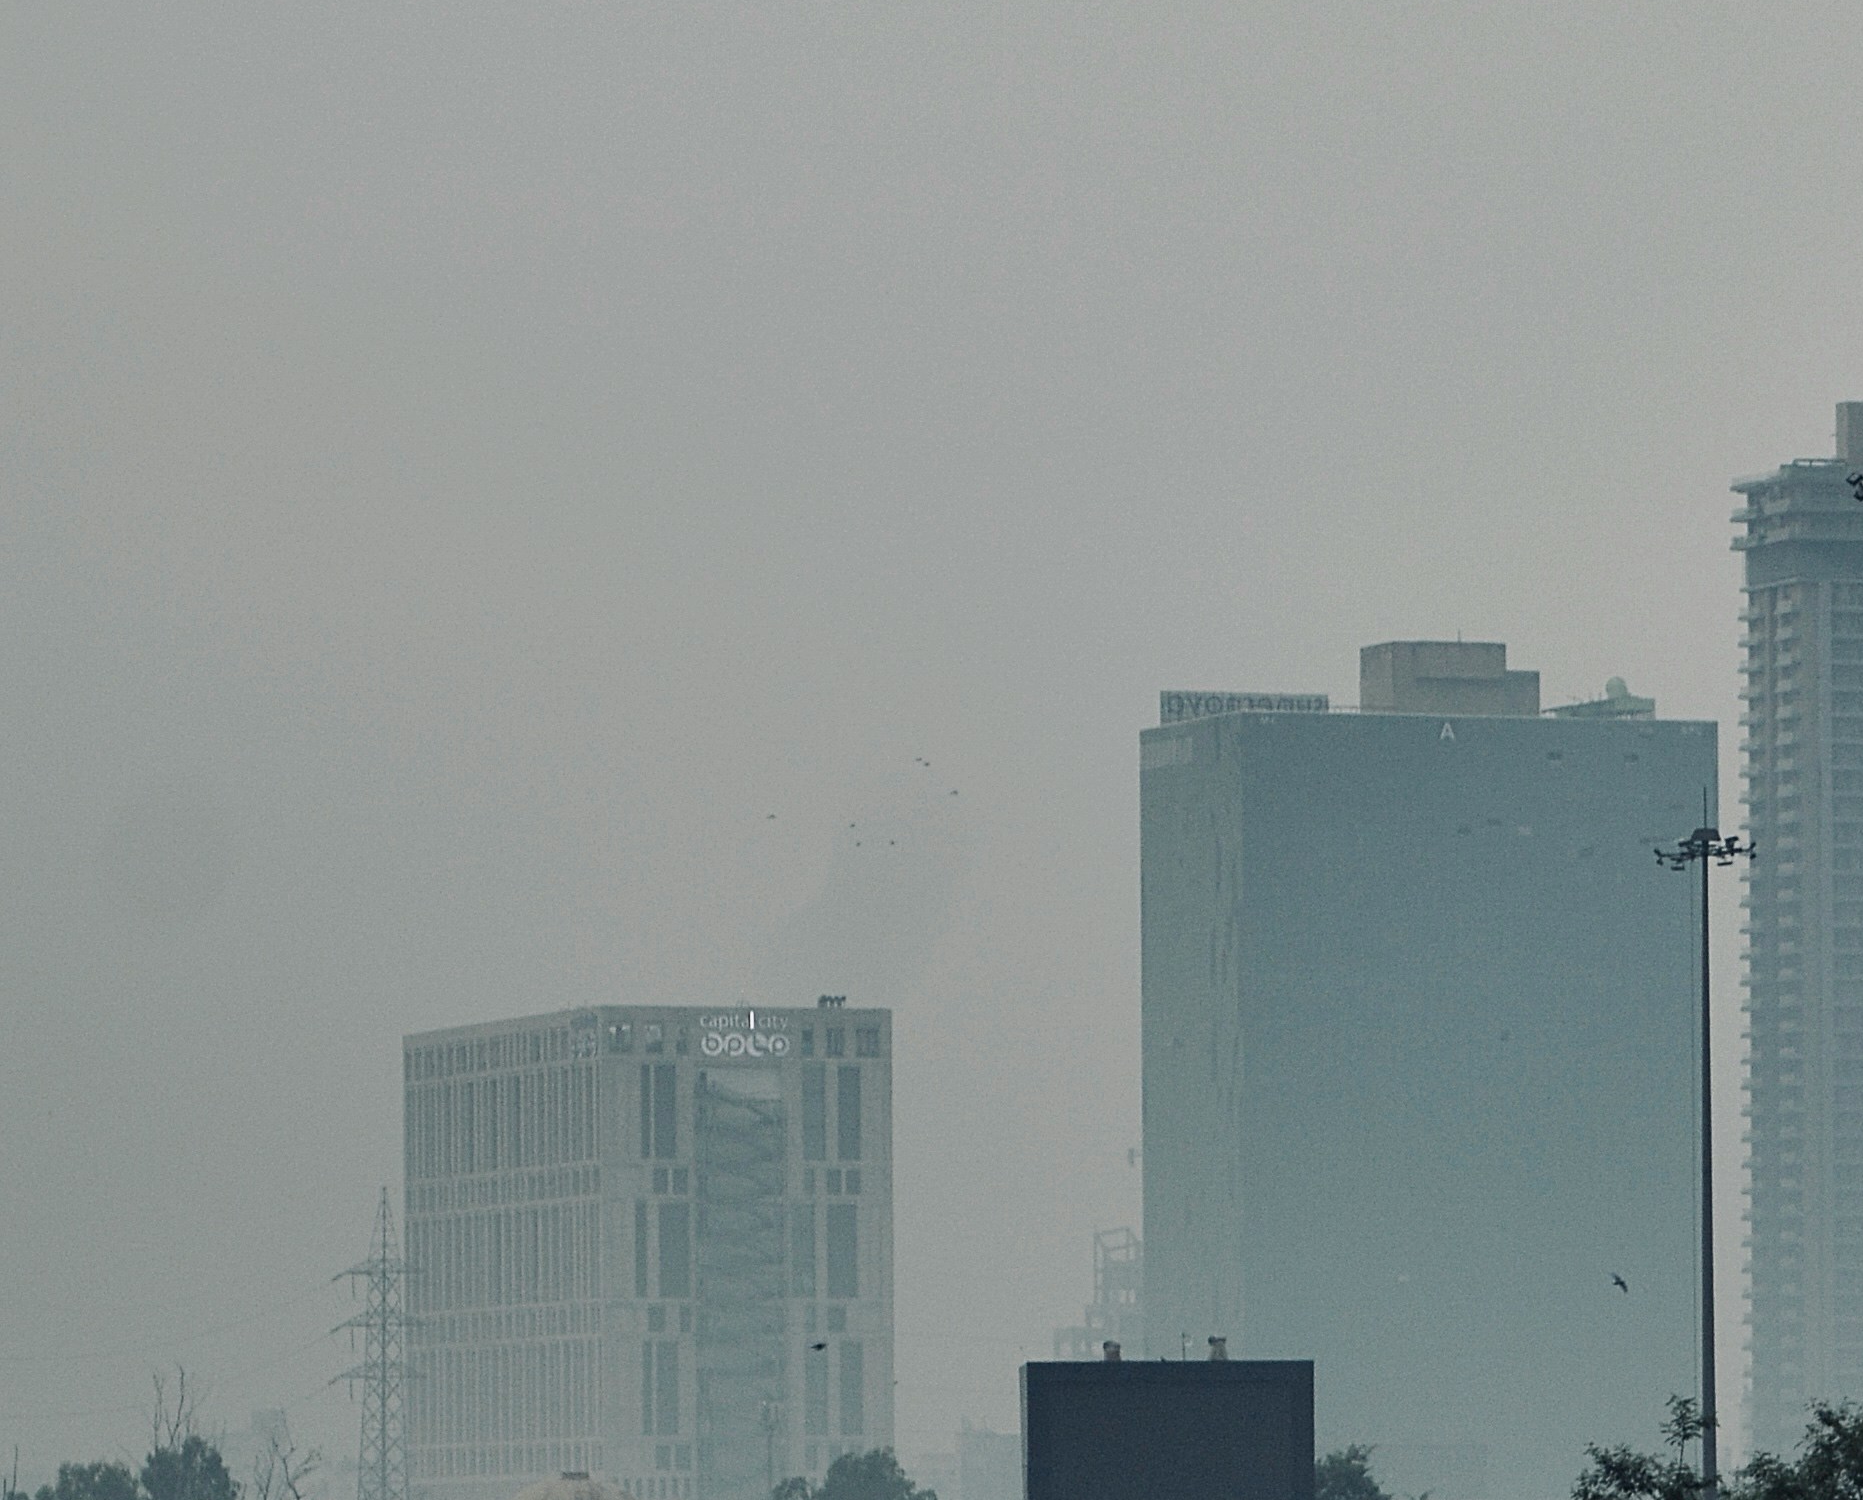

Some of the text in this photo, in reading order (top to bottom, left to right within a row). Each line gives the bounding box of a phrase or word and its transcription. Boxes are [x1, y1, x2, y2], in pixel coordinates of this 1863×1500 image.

[1440, 722, 1455, 740] A
[700, 1010, 789, 1031] capital city
